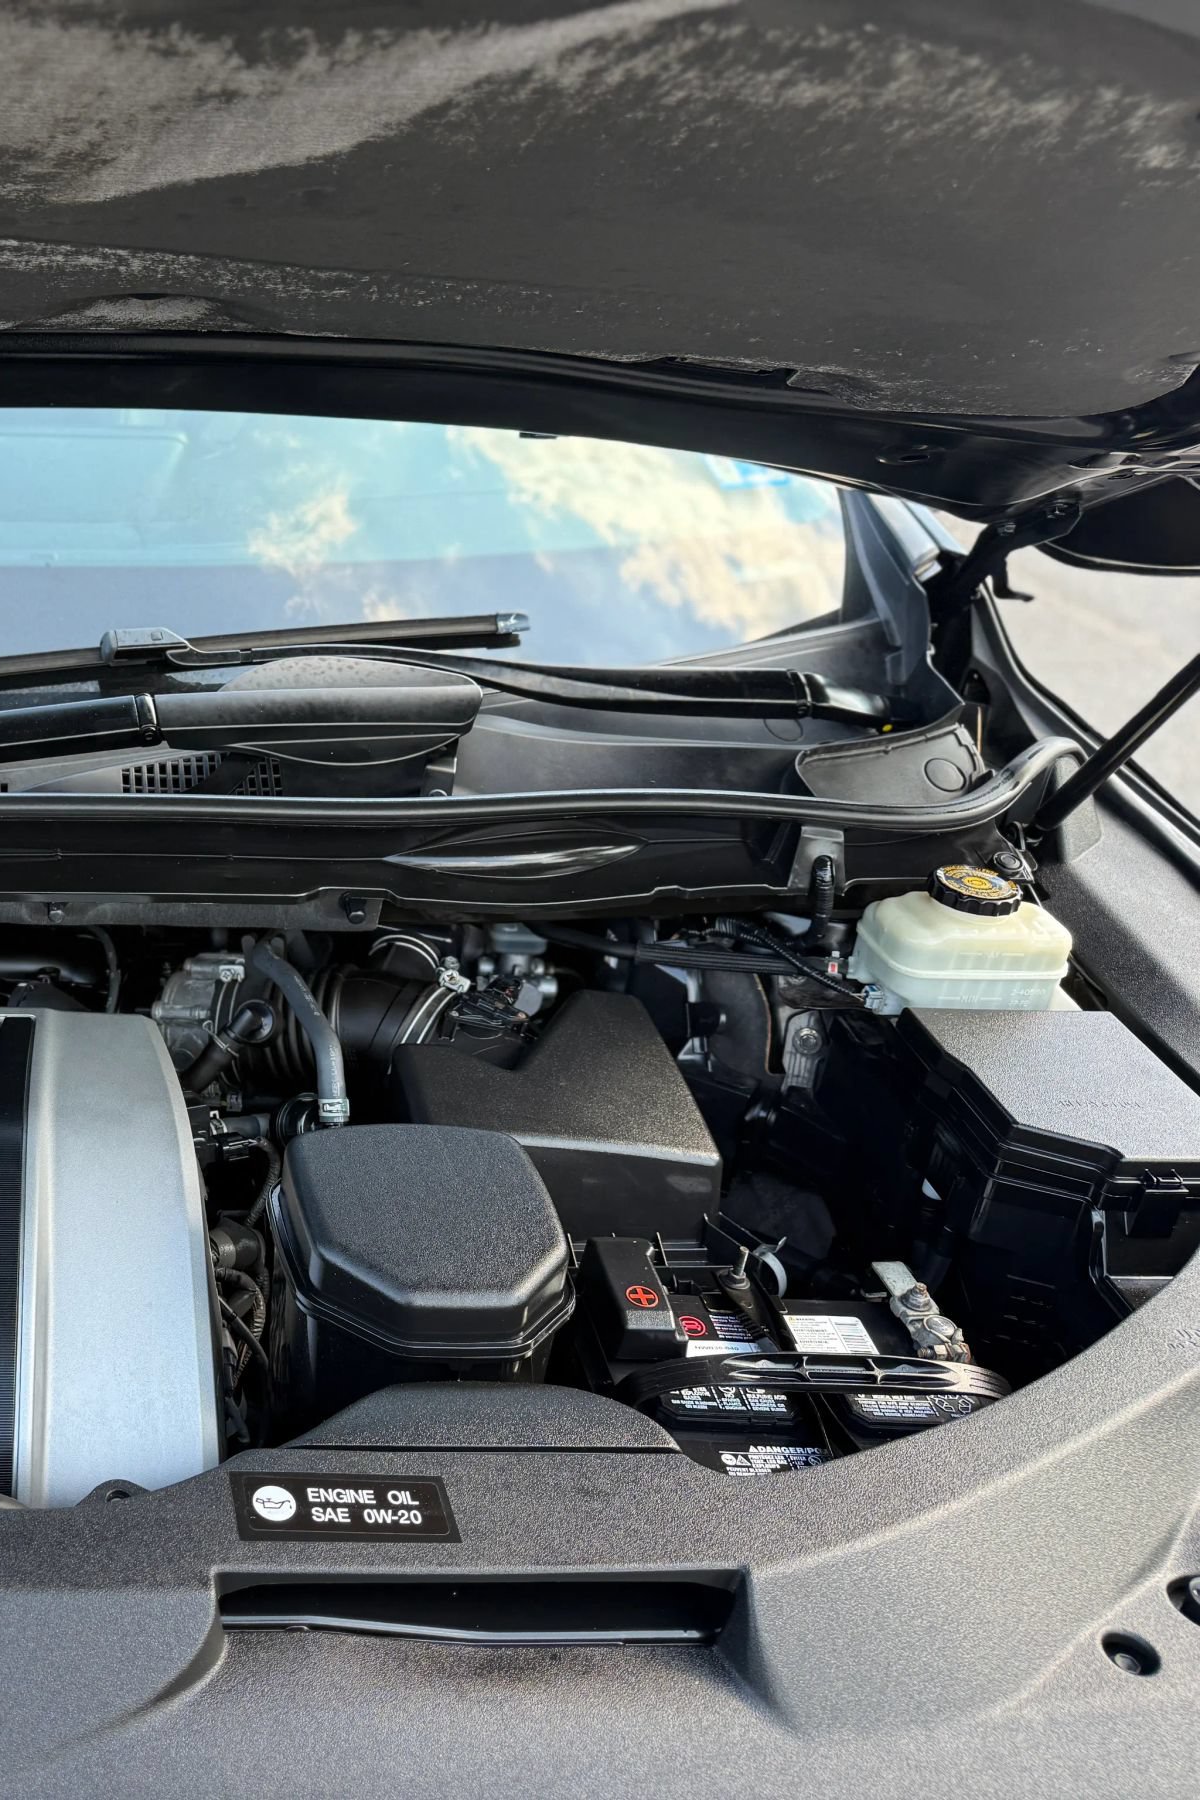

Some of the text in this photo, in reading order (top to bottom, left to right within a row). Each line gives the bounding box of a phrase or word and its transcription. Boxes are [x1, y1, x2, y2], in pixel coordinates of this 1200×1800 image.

[306, 1487, 420, 1506] ENGINE OIL
[311, 1507, 422, 1525] SAE 0W-20
